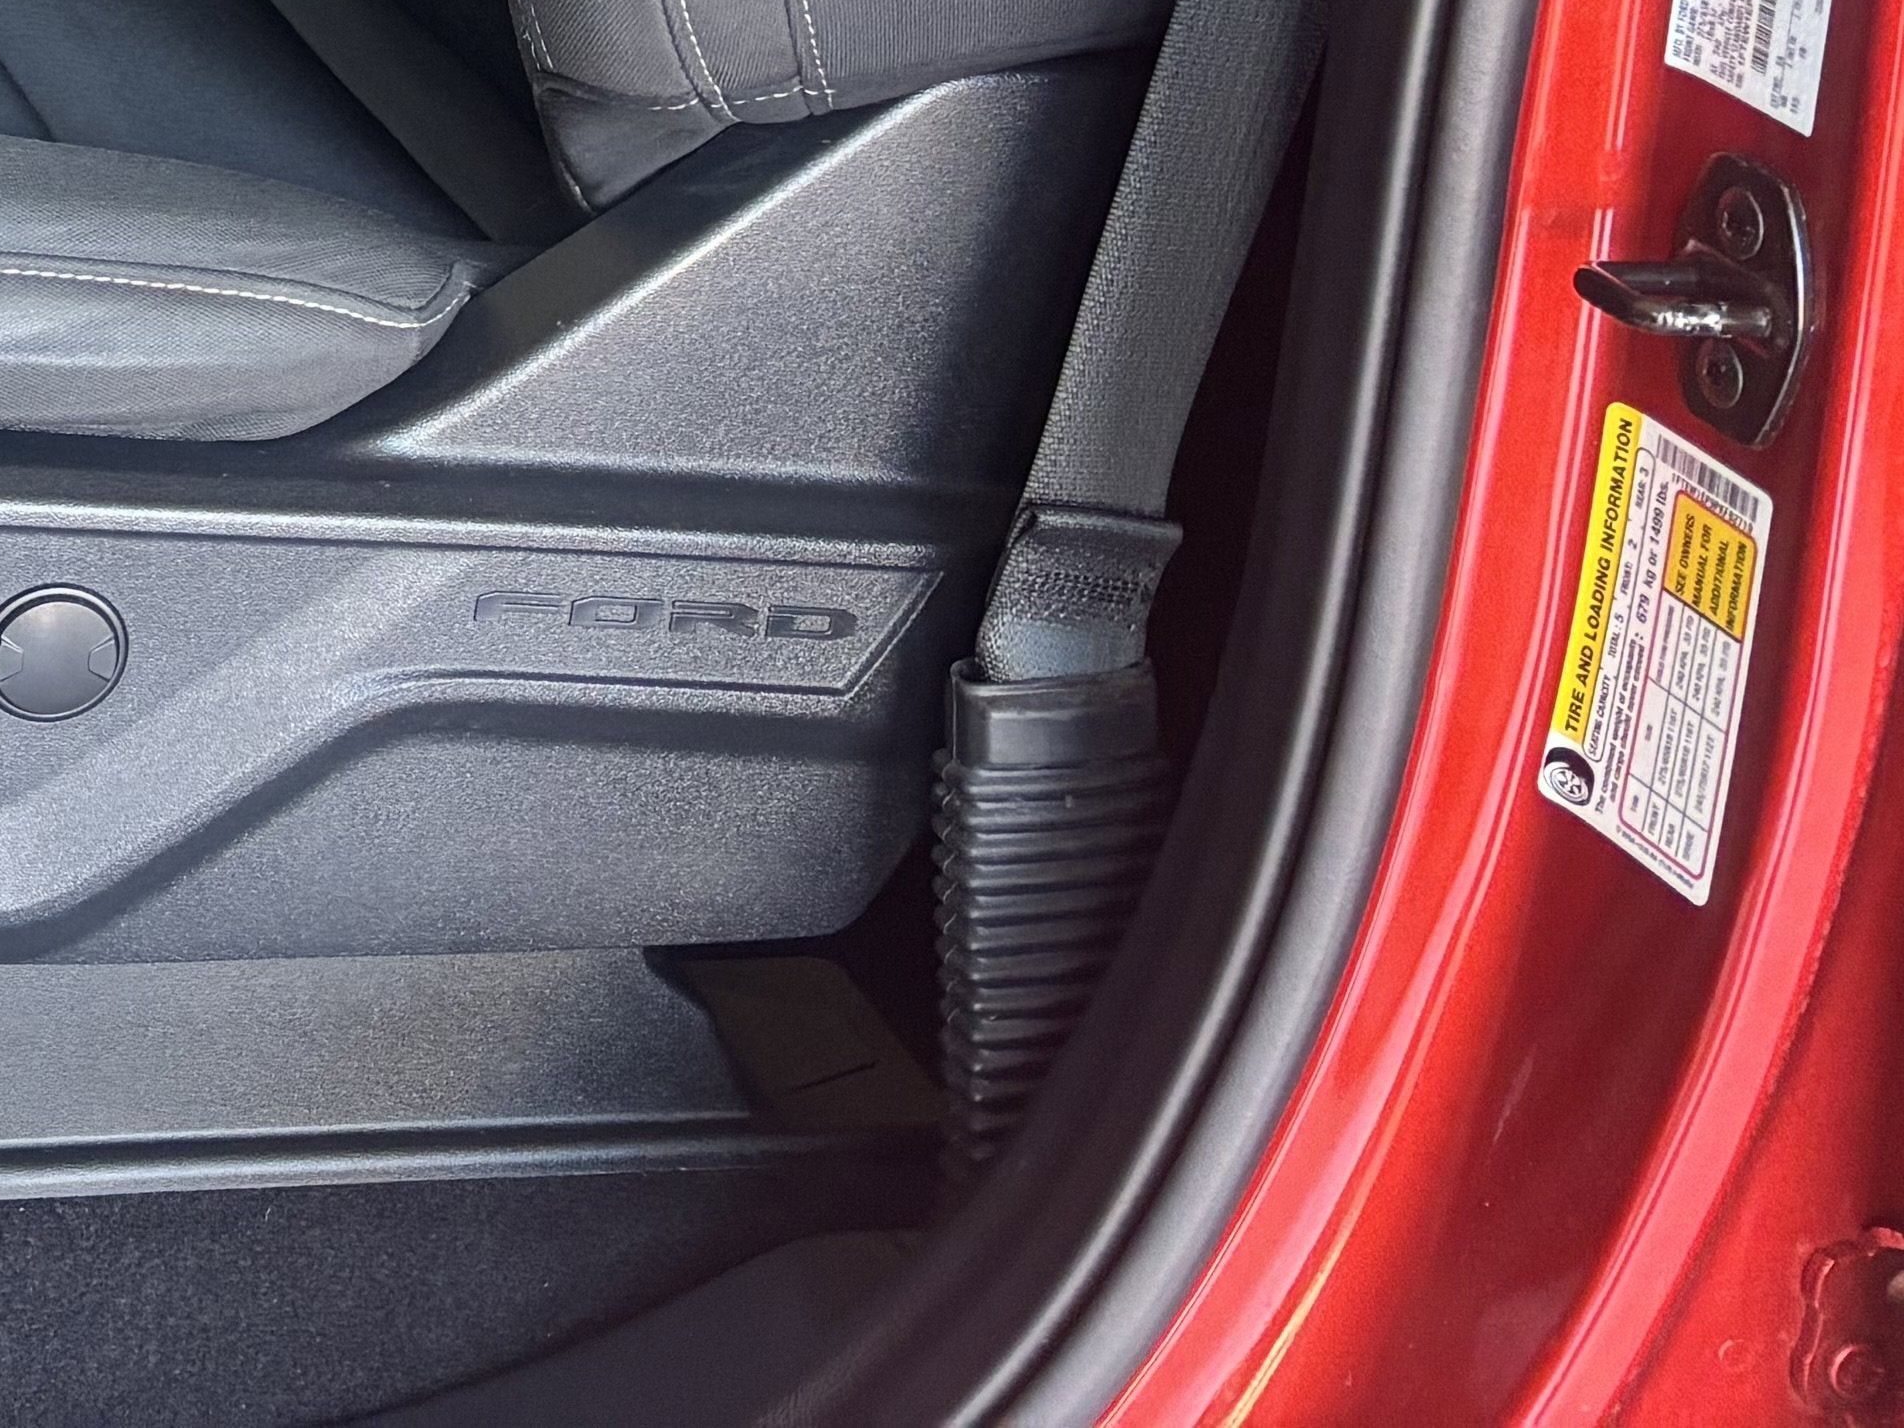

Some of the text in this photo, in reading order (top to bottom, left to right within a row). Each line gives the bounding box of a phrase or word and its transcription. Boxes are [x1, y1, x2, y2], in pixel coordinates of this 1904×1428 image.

[1639, 465, 1649, 477] 3
[1564, 415, 1636, 737] TIRE AND LOADING INFORMATION
[1627, 537, 1637, 550] 2
[1635, 476, 1670, 624] 679 kg or 1499 lbs.
[1674, 511, 1696, 597] SEE OWNERS
[1690, 522, 1712, 607] MANUAL FOR
[1707, 536, 1729, 616] ADDITIONAL
[474, 589, 859, 643] FORD
[1614, 611, 1624, 624] 5
[1724, 540, 1747, 632] INFORMATION
[1596, 672, 1611, 719] CAPACITY
